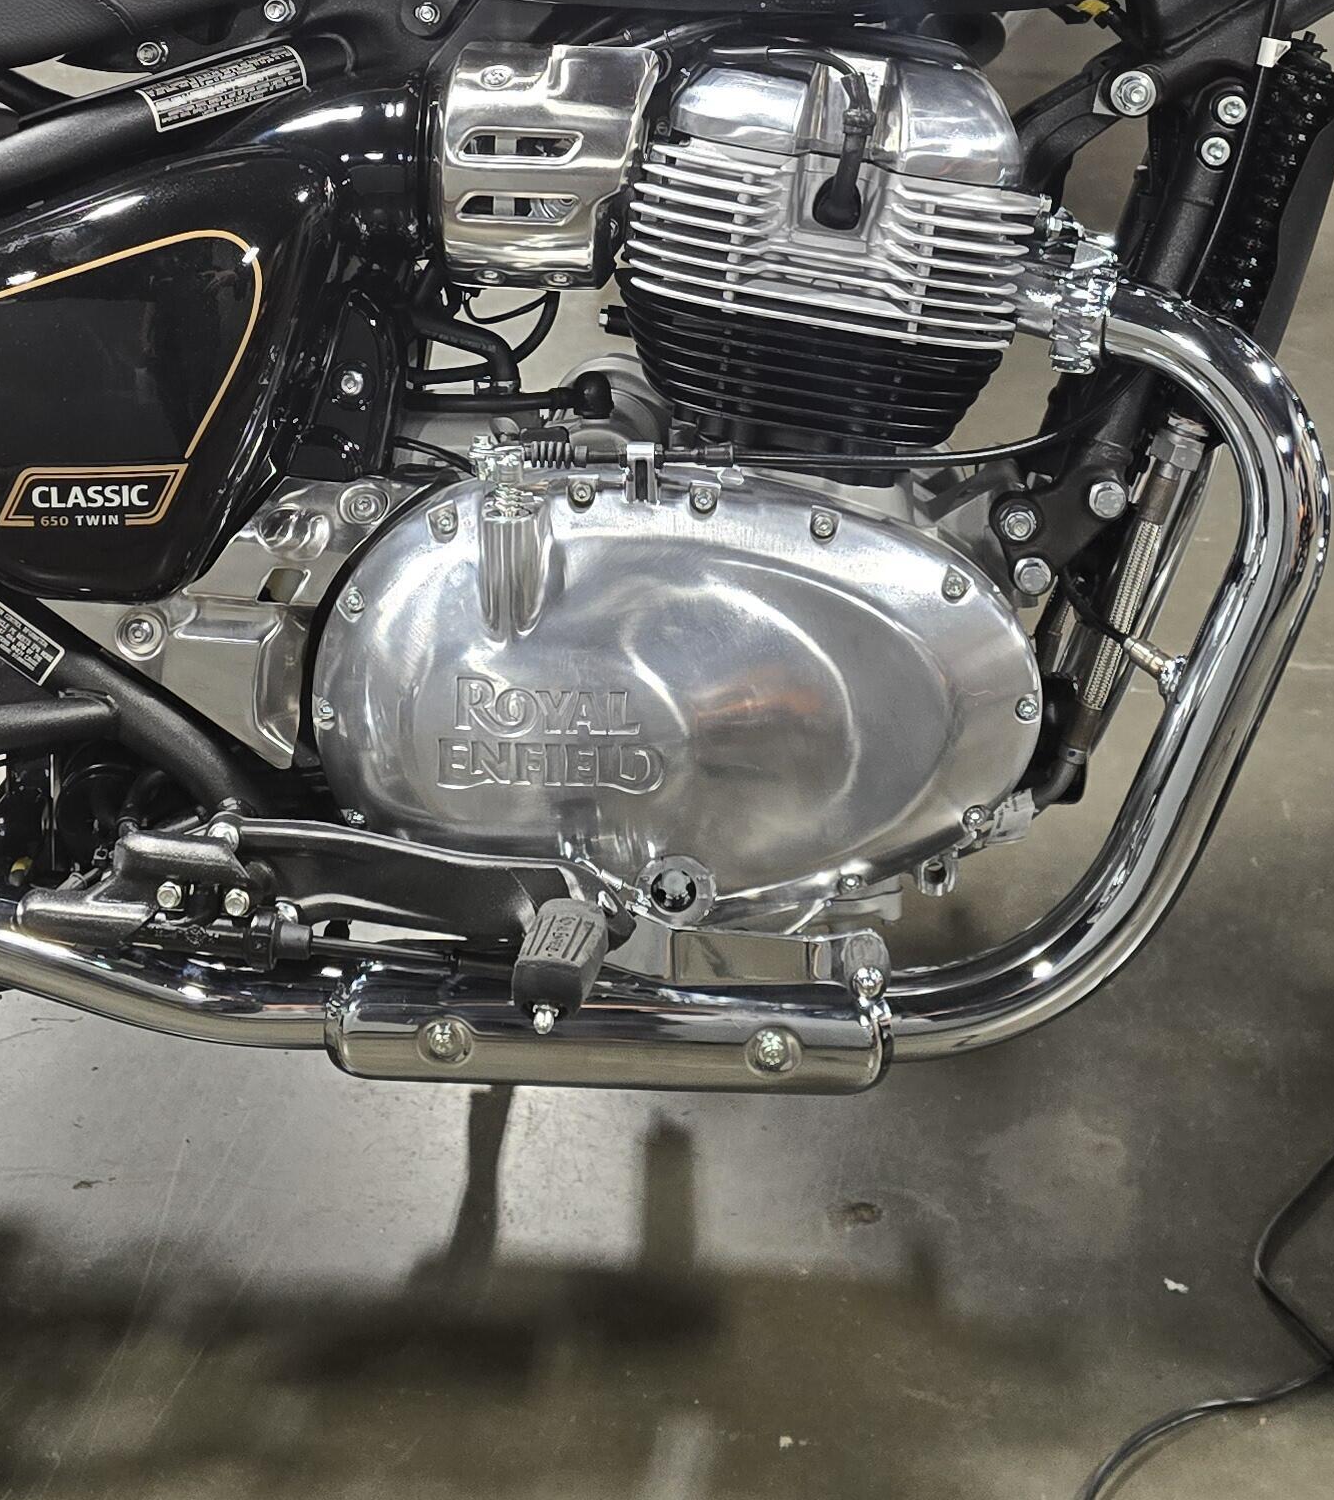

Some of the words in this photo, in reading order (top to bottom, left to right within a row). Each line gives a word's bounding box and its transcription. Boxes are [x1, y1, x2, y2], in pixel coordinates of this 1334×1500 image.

[31, 484, 150, 508] CLASSIC
[40, 515, 69, 527] 650
[75, 514, 119, 526] TWIN
[455, 676, 641, 738] ROYAL
[437, 737, 665, 794] ENFIELD
